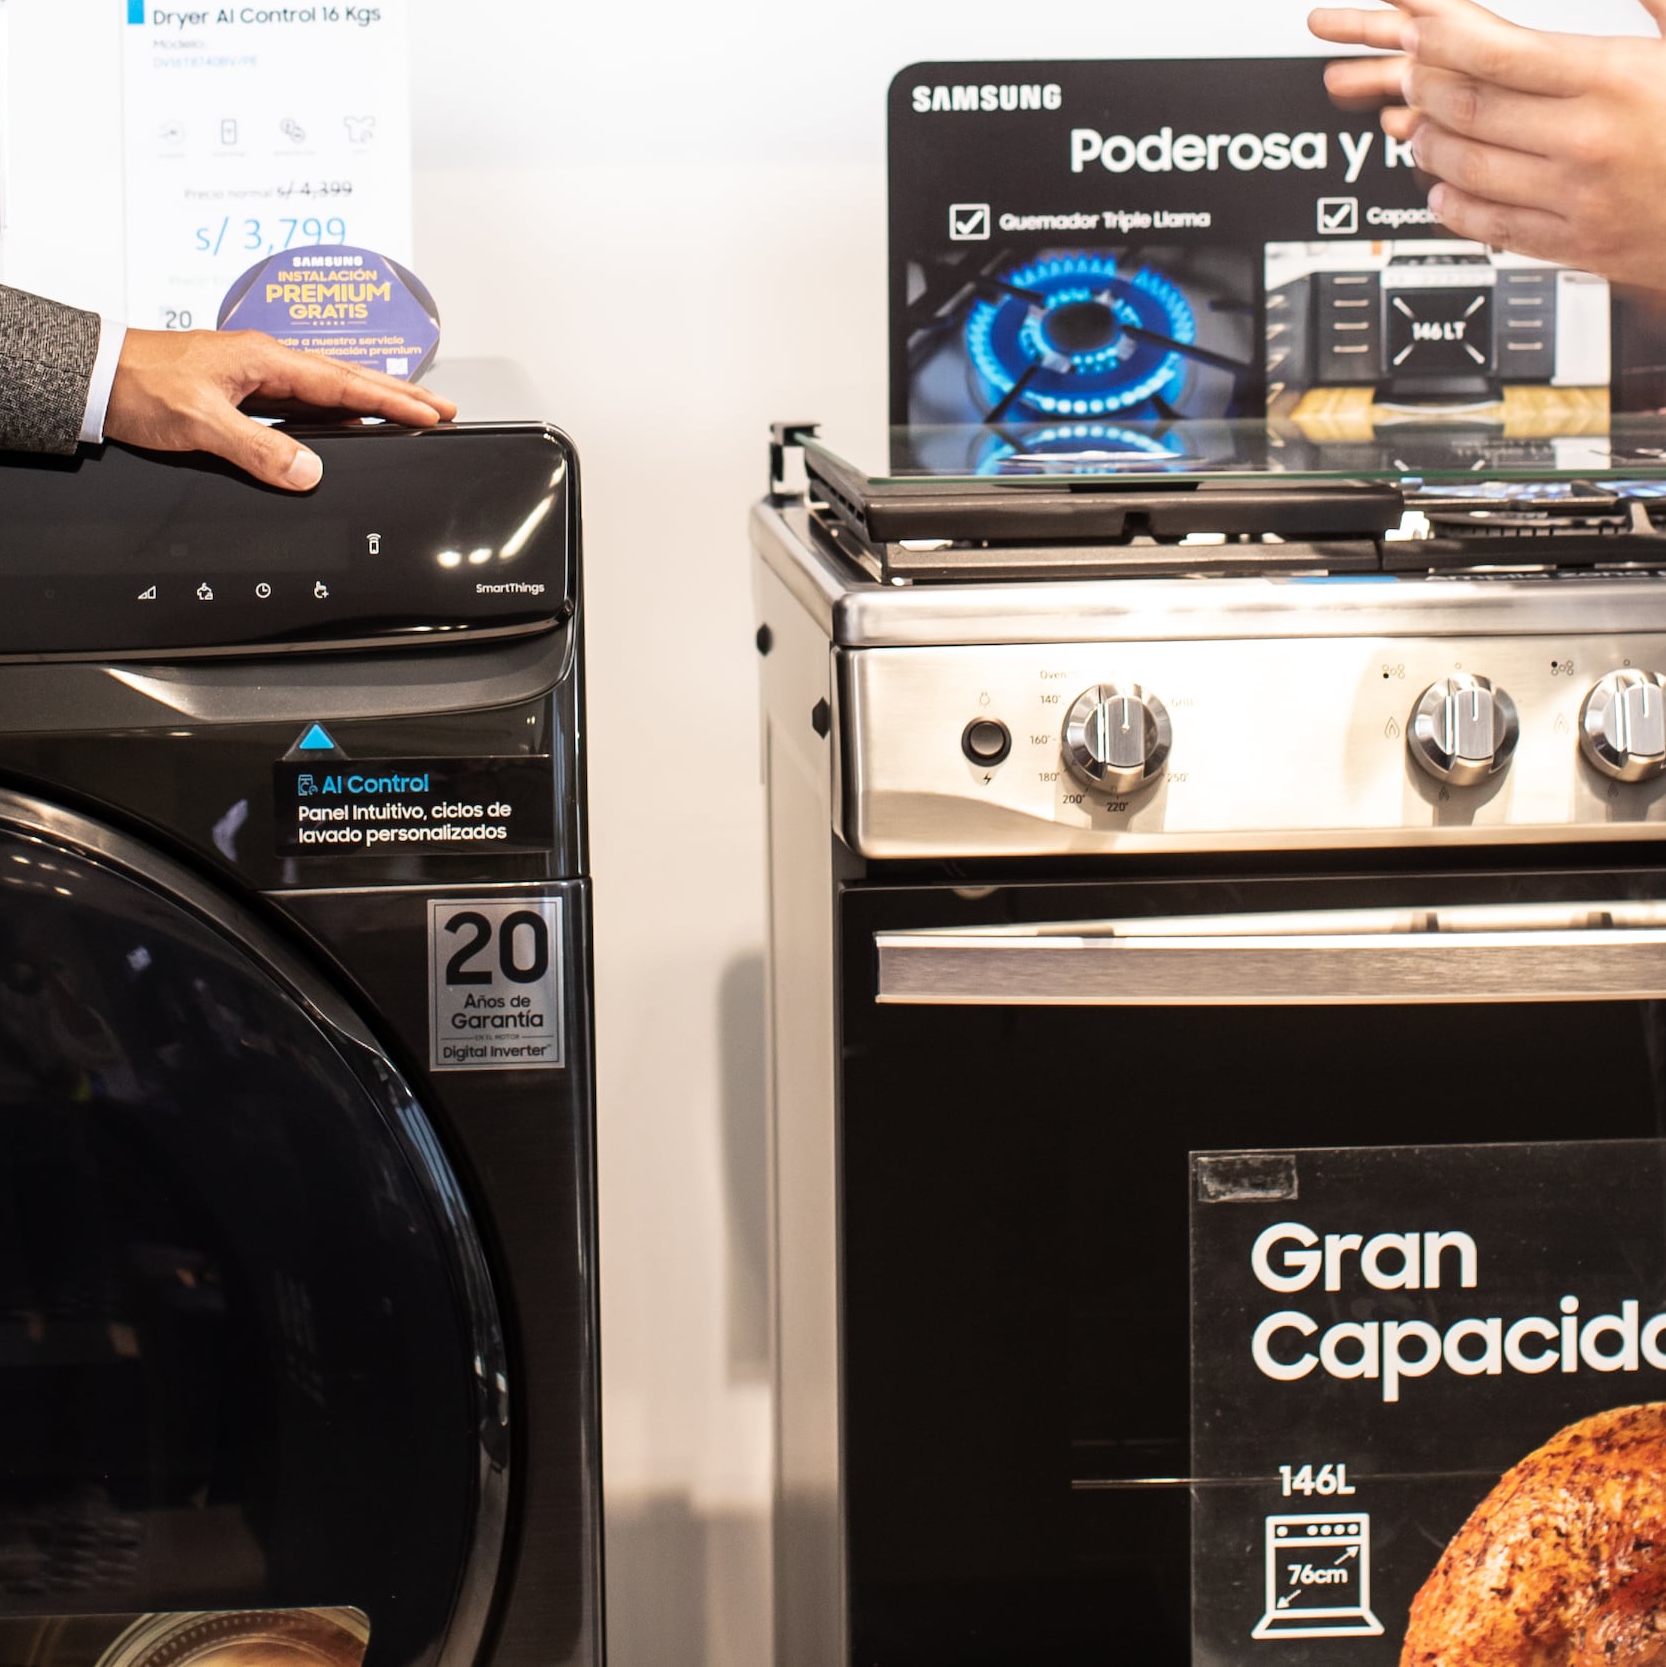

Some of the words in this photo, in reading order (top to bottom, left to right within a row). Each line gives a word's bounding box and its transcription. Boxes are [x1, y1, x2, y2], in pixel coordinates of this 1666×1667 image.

[153, 9, 209, 30] Dryer
[217, 9, 234, 23] AI
[240, 7, 316, 24] Control
[322, 7, 339, 22] 16
[346, 6, 381, 27] Kgs
[912, 83, 1062, 113] SAMSUNG
[1070, 127, 1328, 173] Poderosa
[1338, 131, 1374, 183] y
[999, 212, 1100, 231] Quemador
[1102, 209, 1153, 233] Triple
[1153, 210, 1211, 229] Llama
[244, 217, 346, 255] 3,799
[292, 256, 364, 267] SAMSUNG
[278, 269, 377, 282] INSTALACIÓN
[266, 282, 391, 303] PREMIUM
[165, 309, 192, 329] 20
[289, 303, 369, 319] GRATIS
[311, 336, 357, 346] nuestro
[358, 334, 405, 345] servicio
[369, 345, 422, 357] premium
[475, 582, 545, 595] SmartThings
[322, 776, 342, 794] AI
[347, 774, 430, 794] Control
[299, 804, 349, 821] Panel
[352, 802, 428, 821] Intuitivo,
[431, 802, 484, 819] ciclos
[487, 801, 512, 818] de
[1107, 801, 1129, 812] 220°
[299, 827, 363, 844] lavado
[366, 824, 508, 847] personalizados
[444, 910, 549, 985] 20
[464, 994, 506, 1009] Años
[510, 995, 531, 1008] de
[451, 1010, 545, 1030] Garantía
[443, 1045, 487, 1062] Digital
[1250, 1221, 1477, 1293] Gran
[1278, 1463, 1356, 1497] 146L
[1287, 1563, 1348, 1585] 76cm
